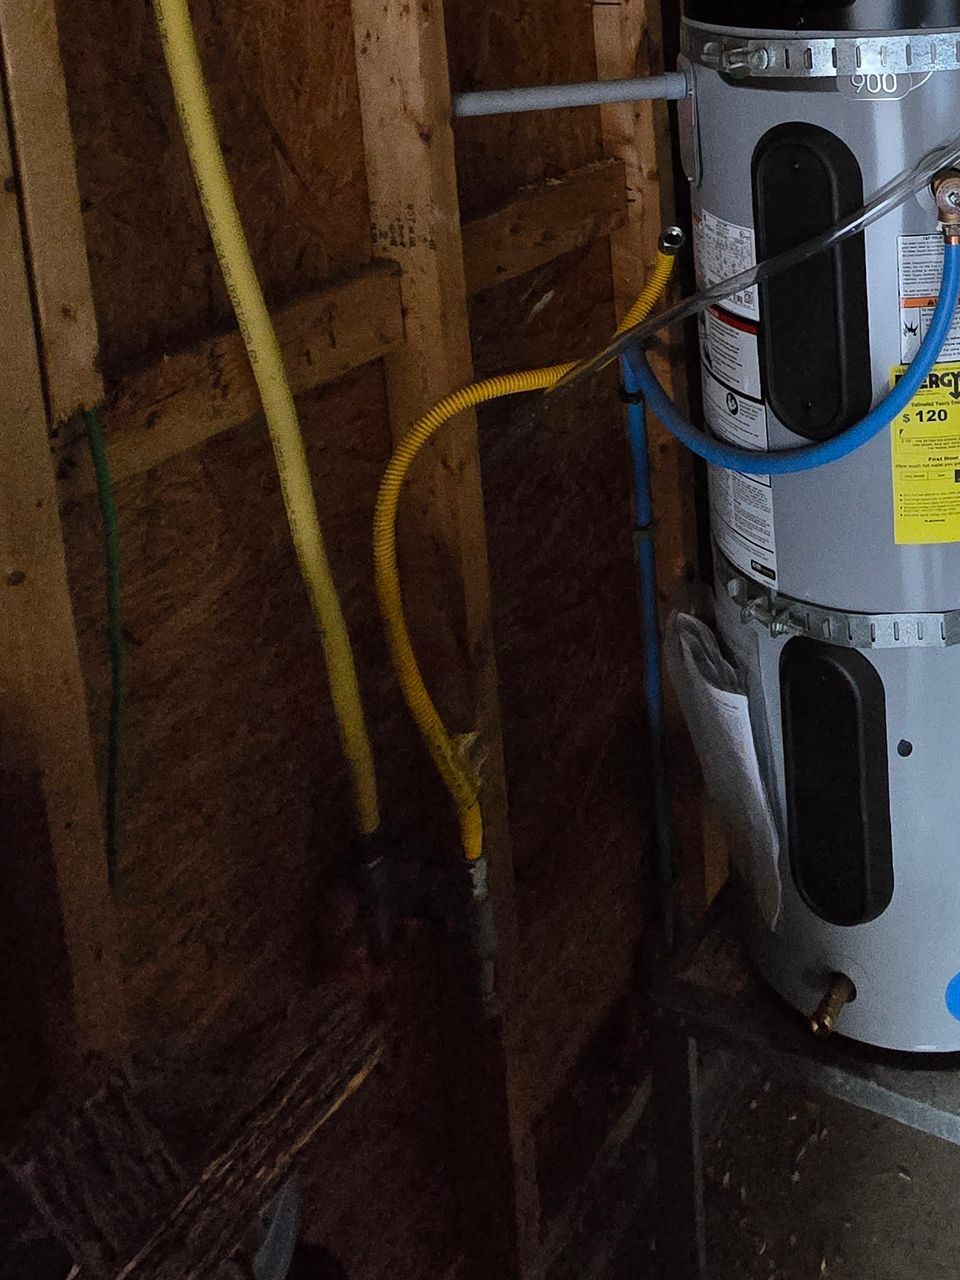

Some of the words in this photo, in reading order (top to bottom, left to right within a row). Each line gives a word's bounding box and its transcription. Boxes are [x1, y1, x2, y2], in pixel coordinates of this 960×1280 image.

[851, 73, 897, 93] 900
[902, 413, 911, 423] $
[915, 409, 948, 423] 120
